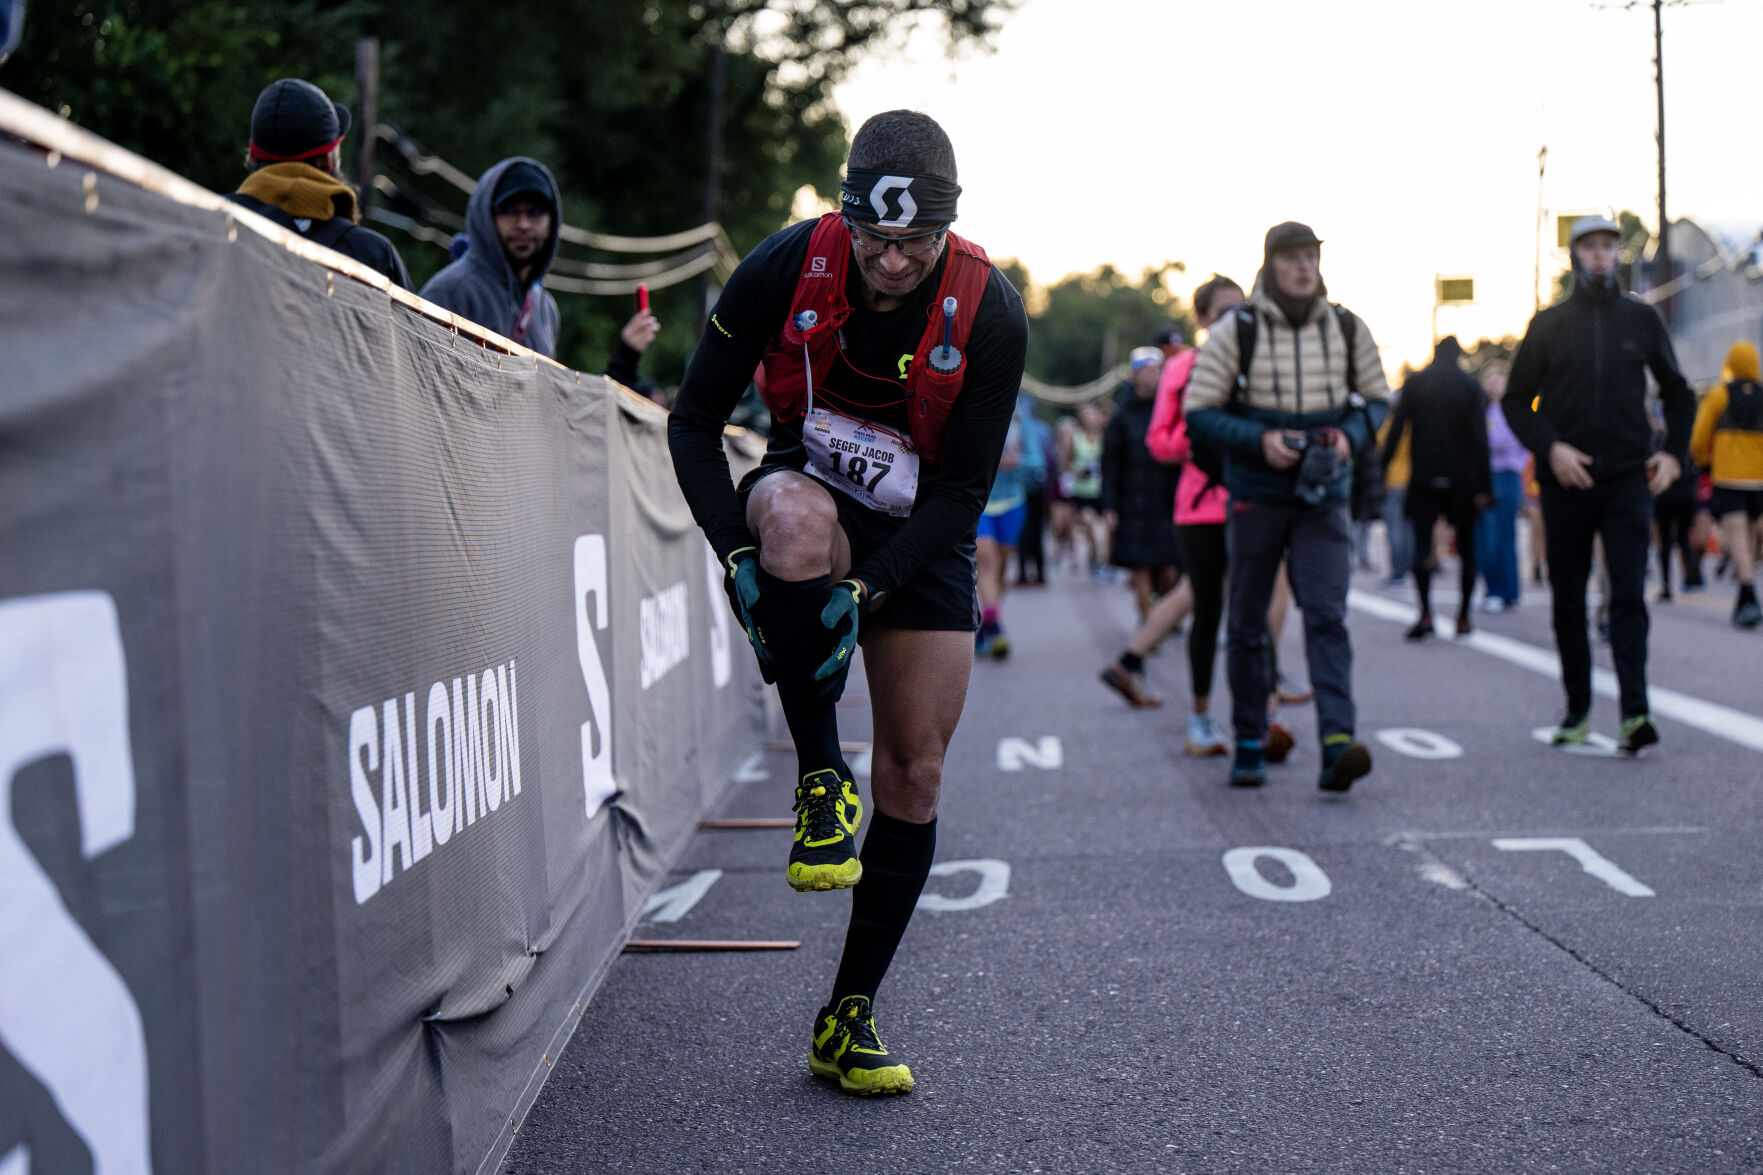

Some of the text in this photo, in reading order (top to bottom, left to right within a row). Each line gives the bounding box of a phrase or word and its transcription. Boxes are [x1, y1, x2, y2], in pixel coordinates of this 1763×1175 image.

[829, 437, 860, 454] SEGEV
[861, 446, 895, 463] JACOB
[829, 451, 891, 494] 187
[349, 659, 522, 905] SALOMON
